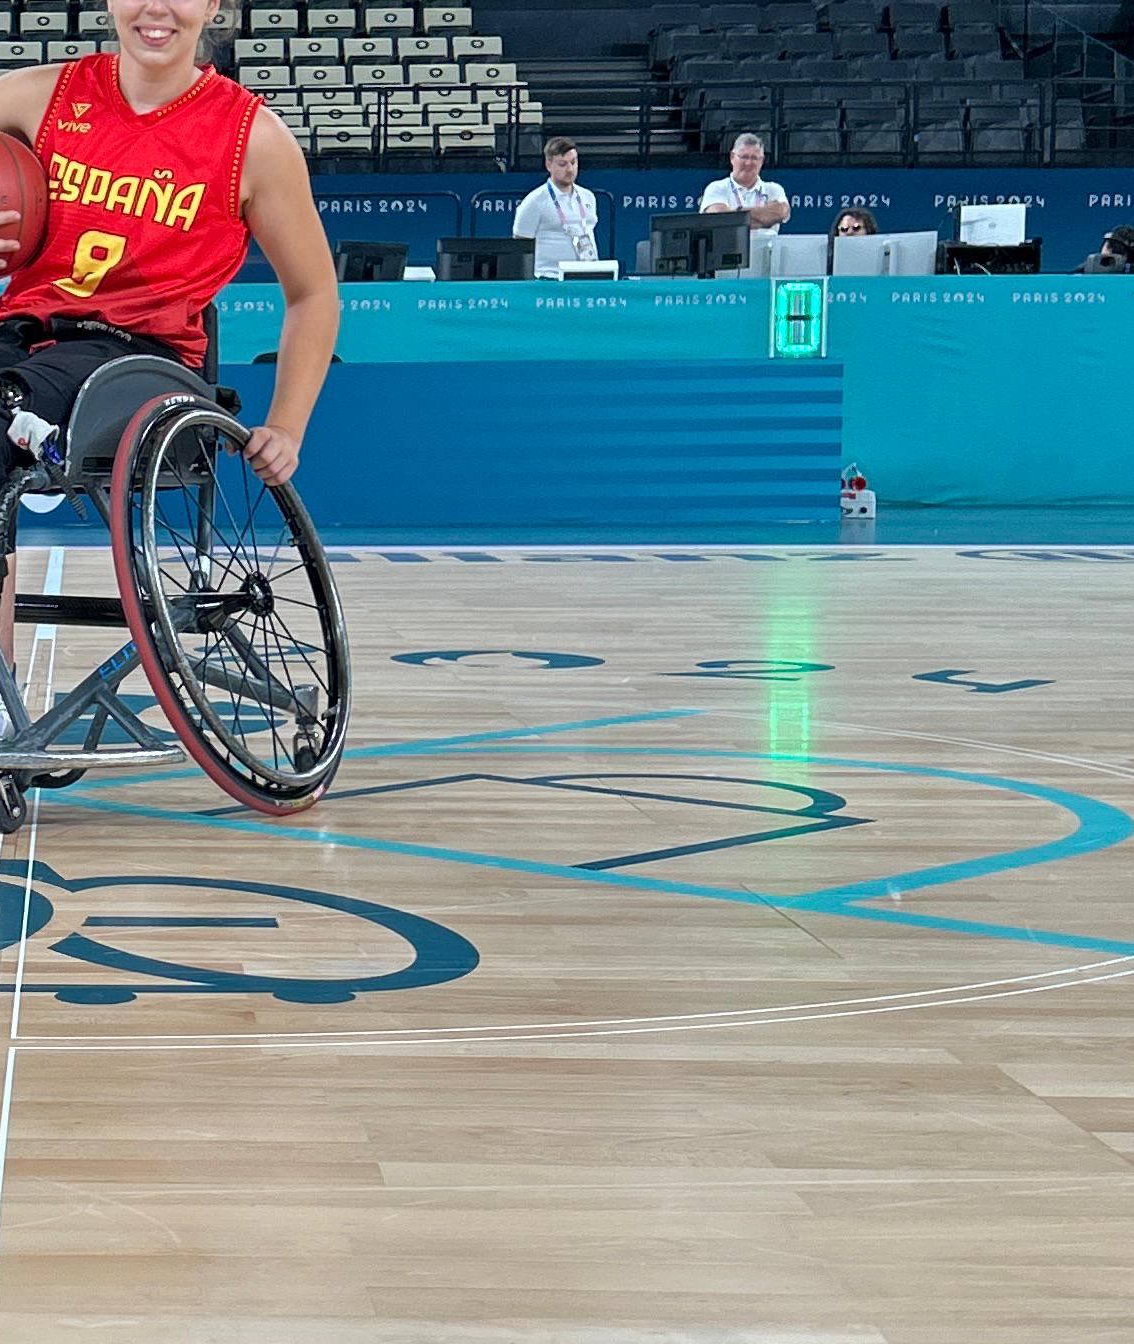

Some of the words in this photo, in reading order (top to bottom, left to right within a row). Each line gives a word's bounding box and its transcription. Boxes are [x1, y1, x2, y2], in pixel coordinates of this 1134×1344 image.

[48, 151, 207, 232] ESPAÑA
[841, 194, 890, 207] 2024
[1089, 194, 1131, 207] PARI
[379, 200, 427, 213] 2024
[50, 229, 127, 299] 9
[587, 297, 627, 308] 2024
[705, 294, 746, 305] 2024
[943, 292, 985, 303] 2024
[1065, 292, 1105, 303] 2024
[234, 301, 274, 312] 2024
[350, 299, 391, 310] 2024
[468, 298, 508, 309] 2024
